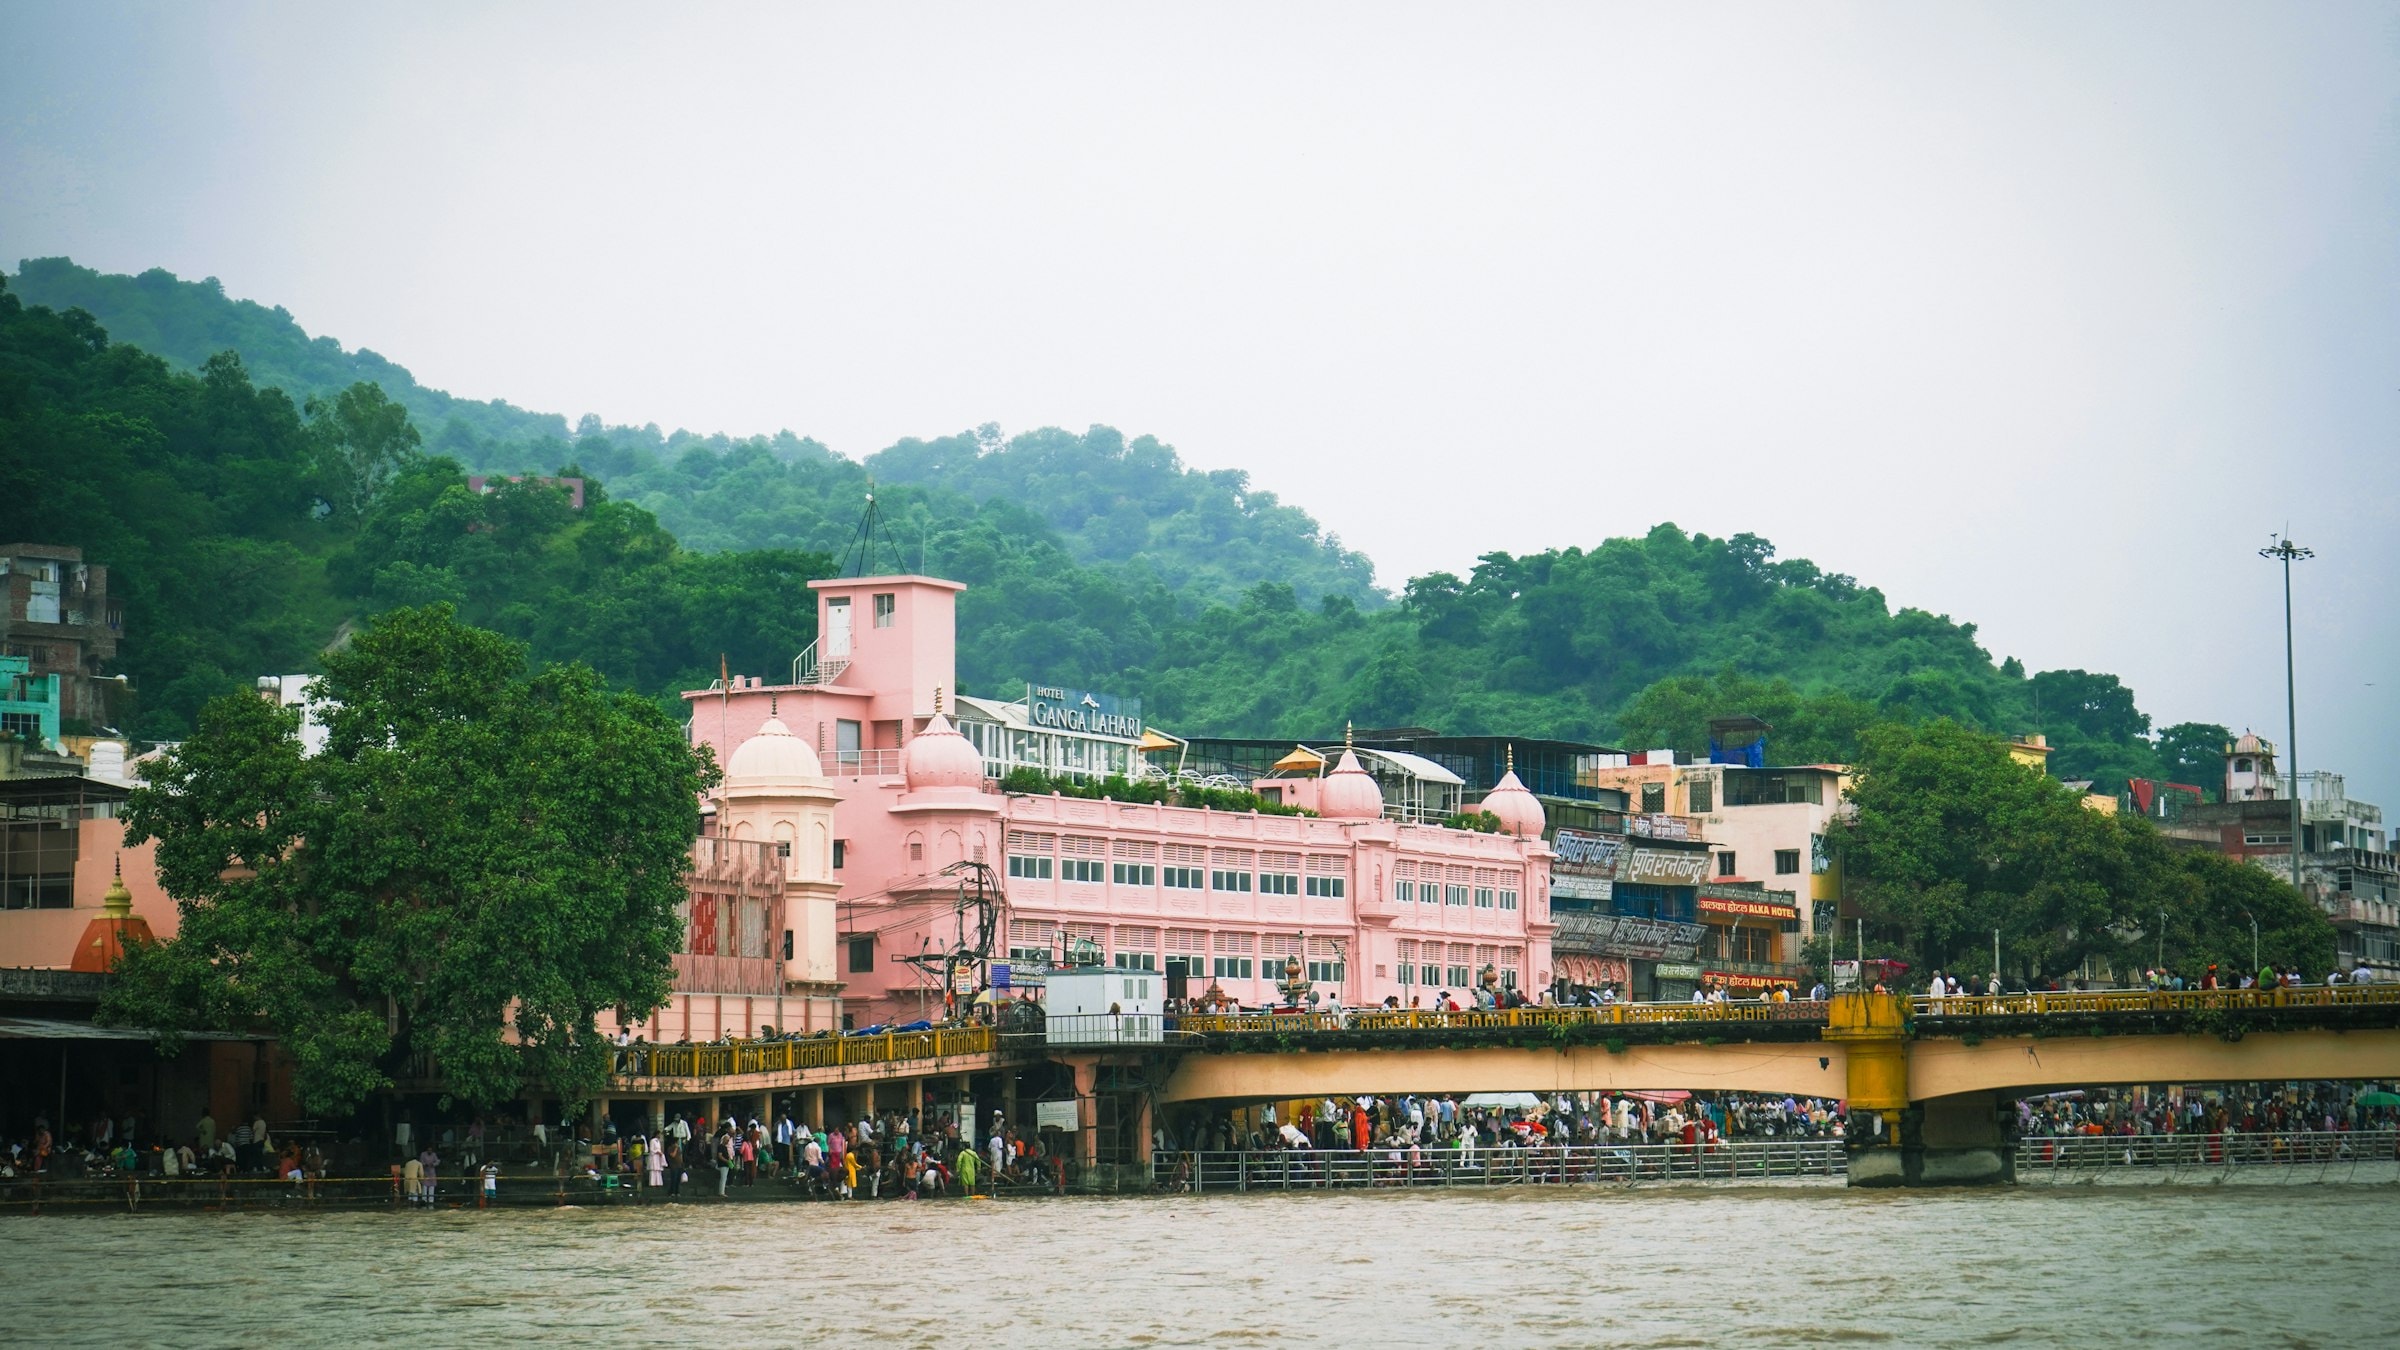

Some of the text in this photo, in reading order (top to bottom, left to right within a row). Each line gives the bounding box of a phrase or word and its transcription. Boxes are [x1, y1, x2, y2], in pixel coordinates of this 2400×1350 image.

[1037, 686, 1066, 700] HOTEL
[1034, 701, 1140, 737] GANGA LAHARI
[1700, 900, 1796, 918] अलका होटल ALKA HOTEL
[1702, 974, 1727, 985] अका
[1729, 974, 1750, 987] होटल
[1750, 977, 1772, 988] ALKA
